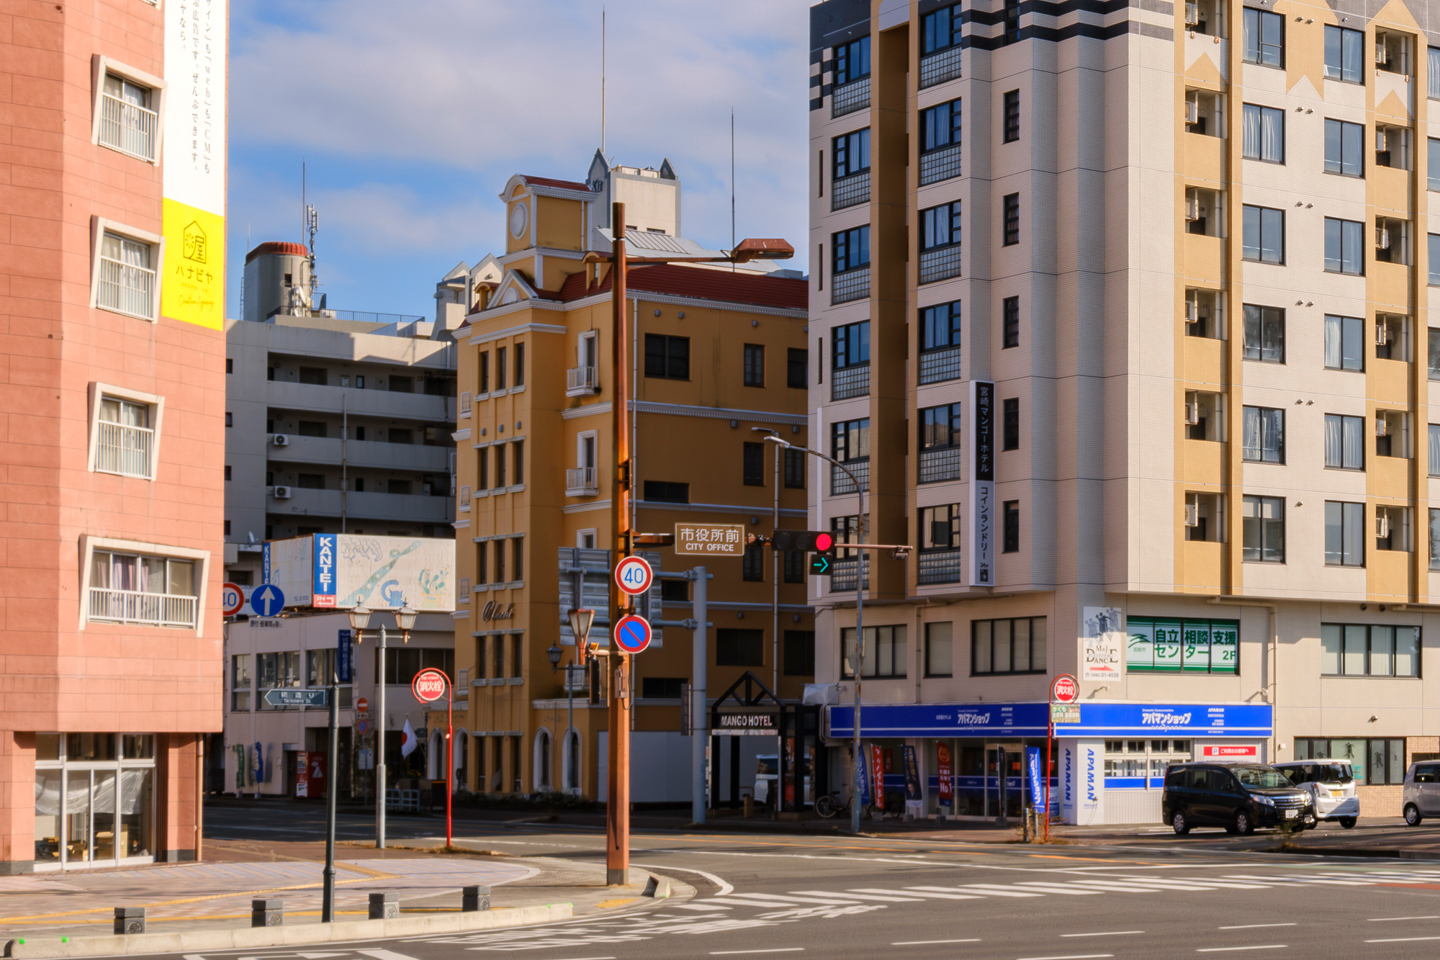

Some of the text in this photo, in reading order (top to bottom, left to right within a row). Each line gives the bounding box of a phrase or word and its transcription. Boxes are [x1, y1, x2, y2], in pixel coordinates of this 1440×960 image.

[176, 265, 213, 285] ハナビヤ
[979, 386, 990, 473] 宮崎マンゴーホテル
[979, 486, 989, 560] コインランドリー
[680, 528, 740, 543] 市役所前
[685, 543, 734, 552] CITY OFFICE
[319, 536, 332, 593] KANTEI
[624, 568, 644, 584] 40
[1155, 629, 1237, 645] 自立相談支援
[1154, 644, 1236, 660] センター 2F
[420, 681, 443, 692] 消火栓
[721, 715, 773, 727] MANGO HOTEL
[957, 712, 990, 724] アパマンショップ
[1142, 712, 1192, 724] アパマンショップ
[1087, 748, 1095, 801] APAMAN
